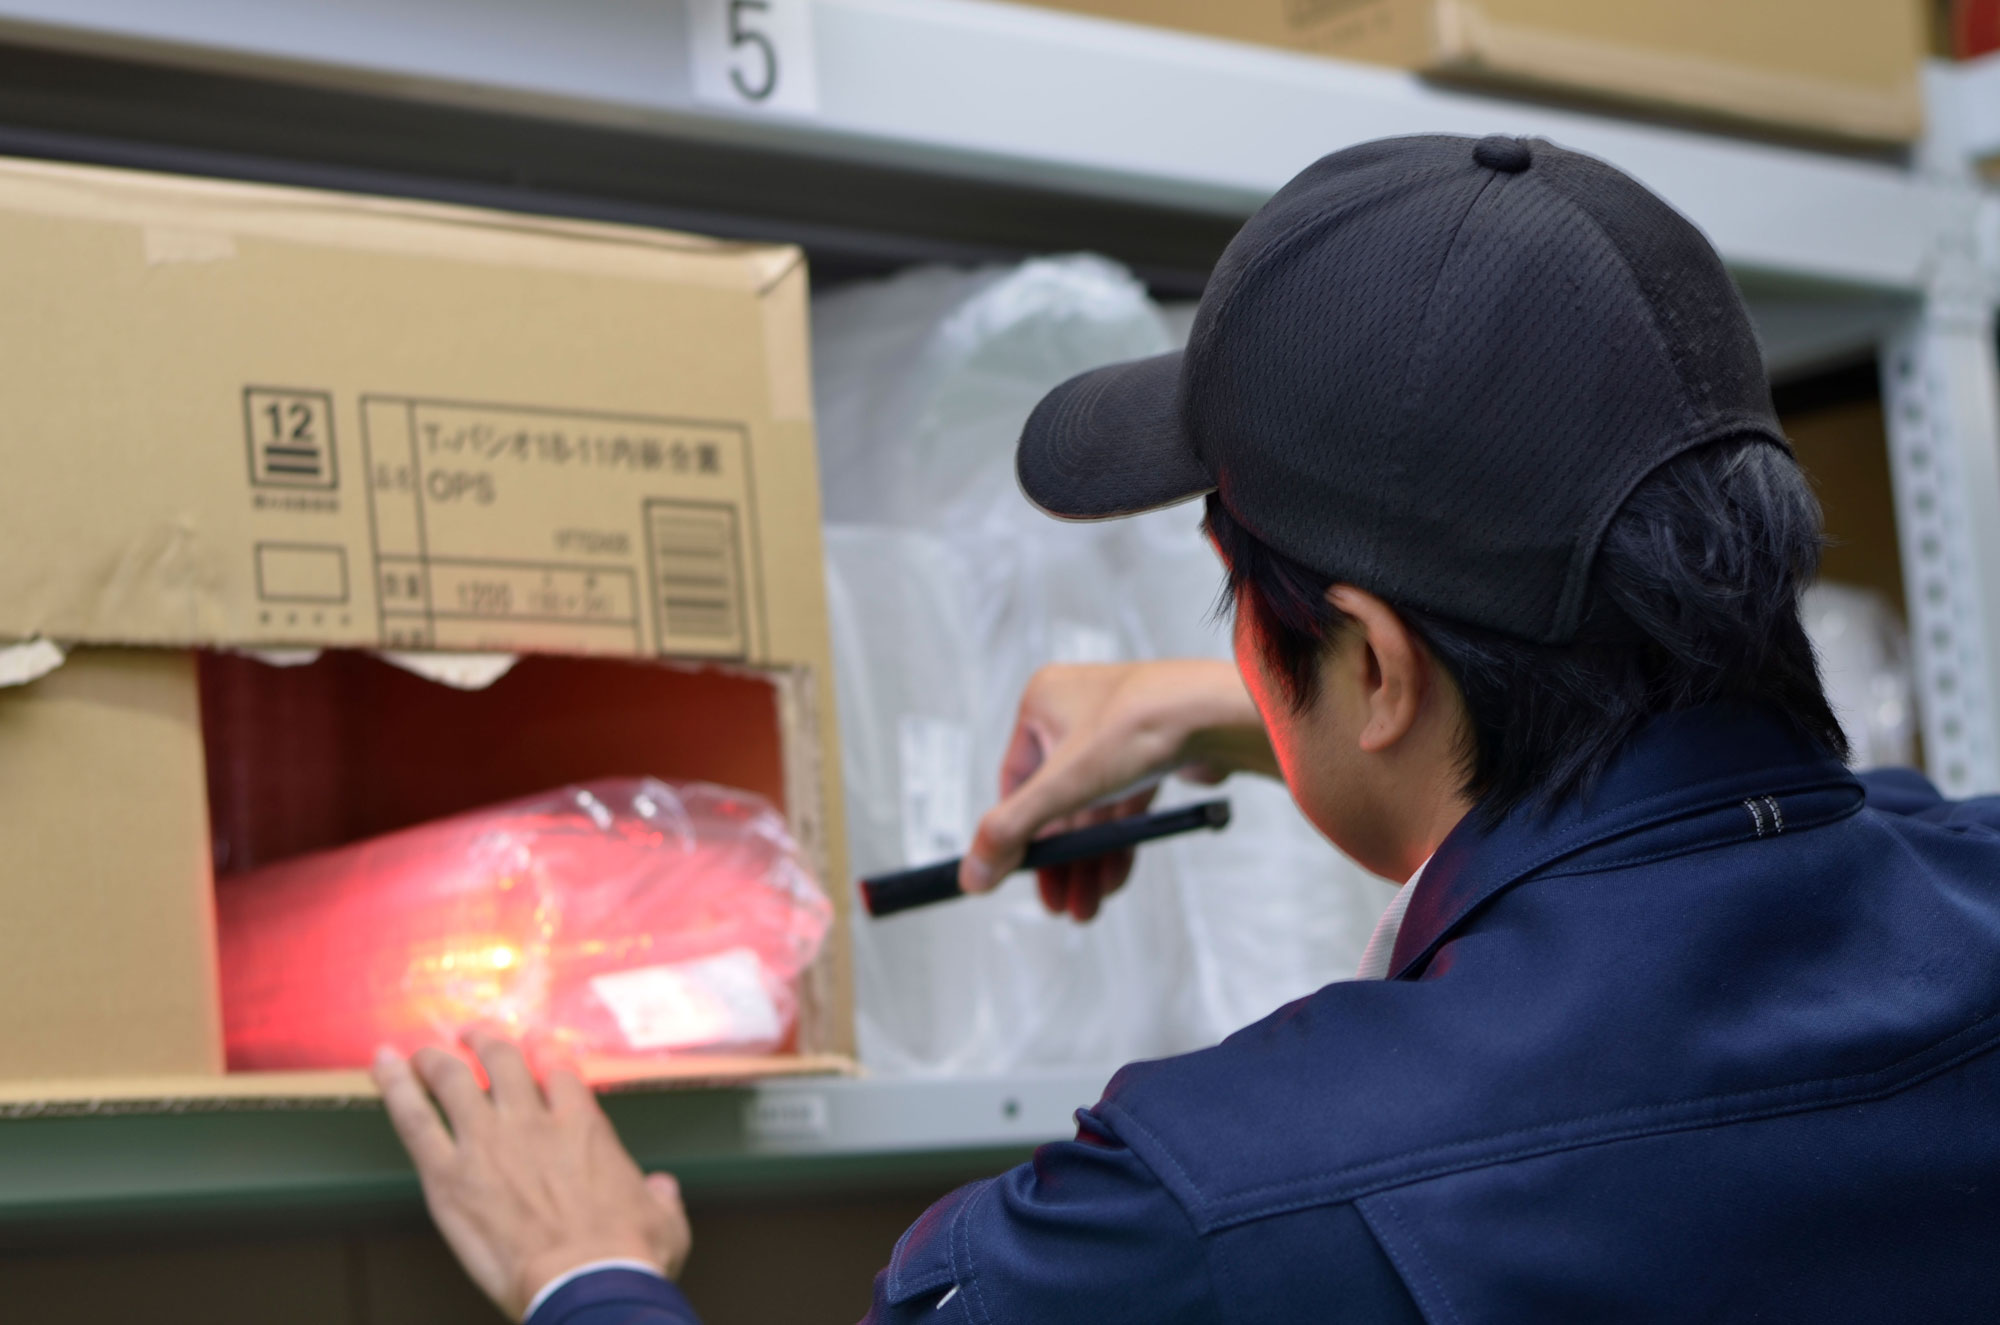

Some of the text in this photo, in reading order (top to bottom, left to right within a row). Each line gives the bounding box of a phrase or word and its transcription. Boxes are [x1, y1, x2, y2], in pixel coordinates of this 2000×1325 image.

[727, 0, 778, 102] 5
[264, 402, 315, 441] 12
[427, 467, 496, 505] OPS
